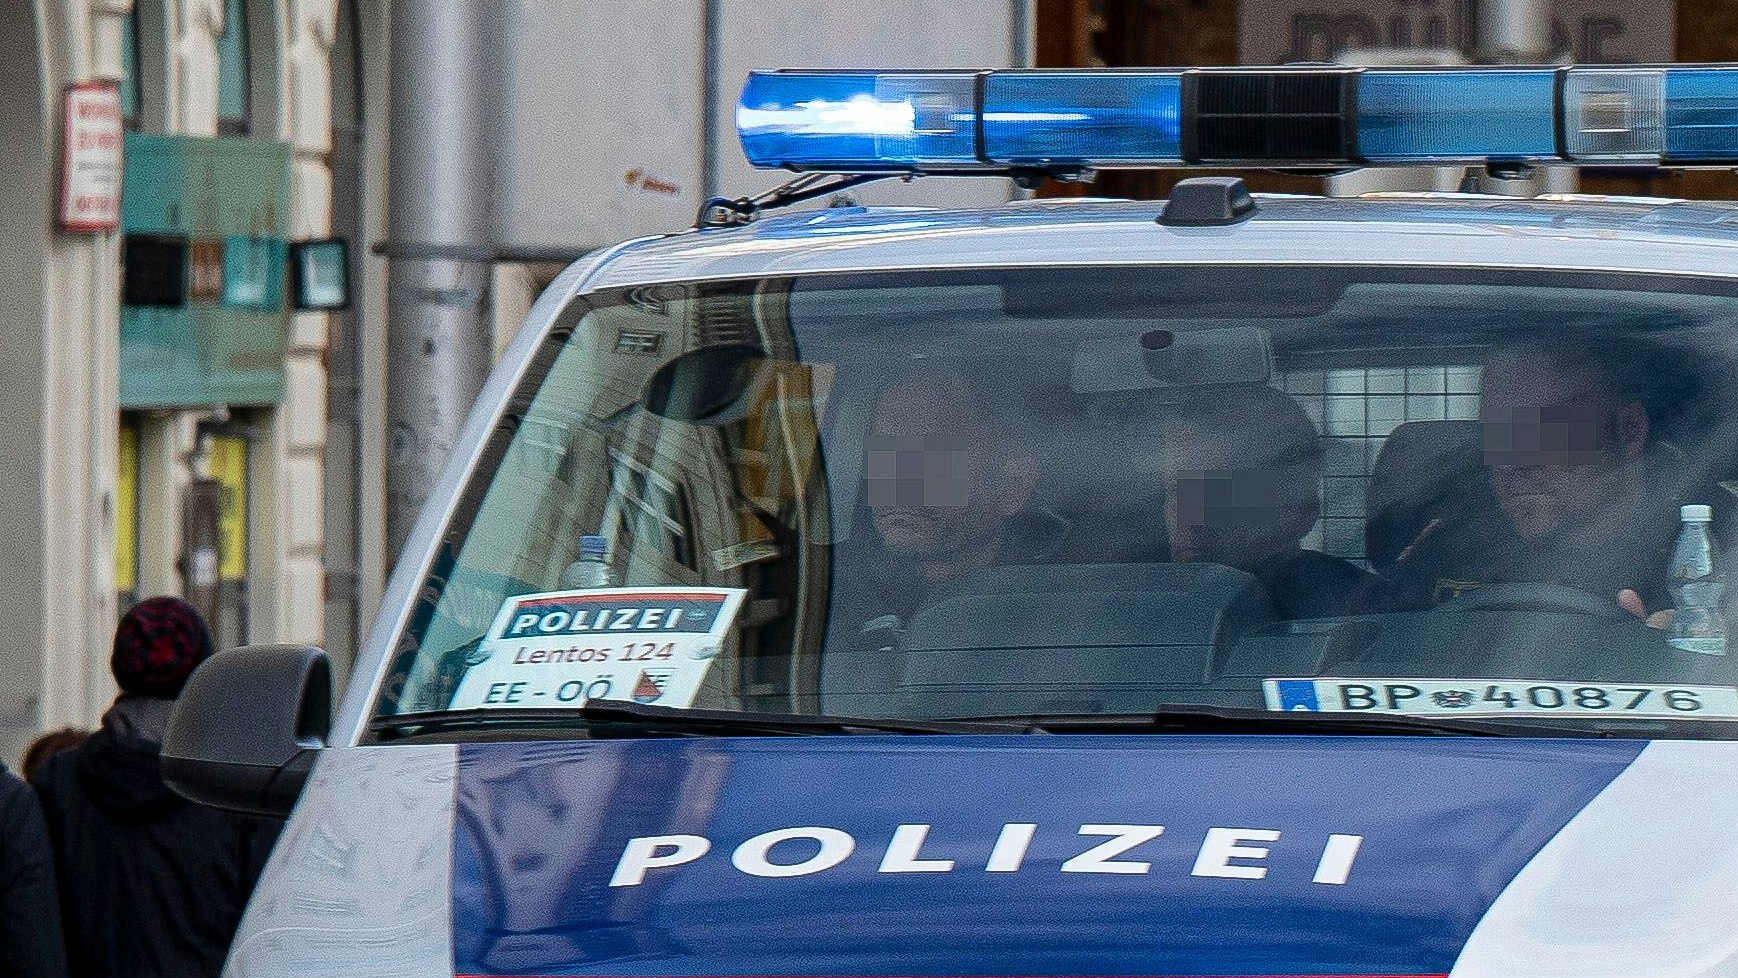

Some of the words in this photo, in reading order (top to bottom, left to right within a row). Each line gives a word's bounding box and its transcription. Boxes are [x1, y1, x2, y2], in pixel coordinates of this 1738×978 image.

[511, 608, 684, 634] POLIZEI
[512, 645, 610, 665] Lentos
[616, 642, 676, 663] 124
[482, 681, 528, 705] EE
[556, 673, 614, 703] OÖ
[1336, 683, 1421, 711] BP
[1481, 685, 1703, 713] 40876
[608, 823, 1364, 887] POLIZEI
